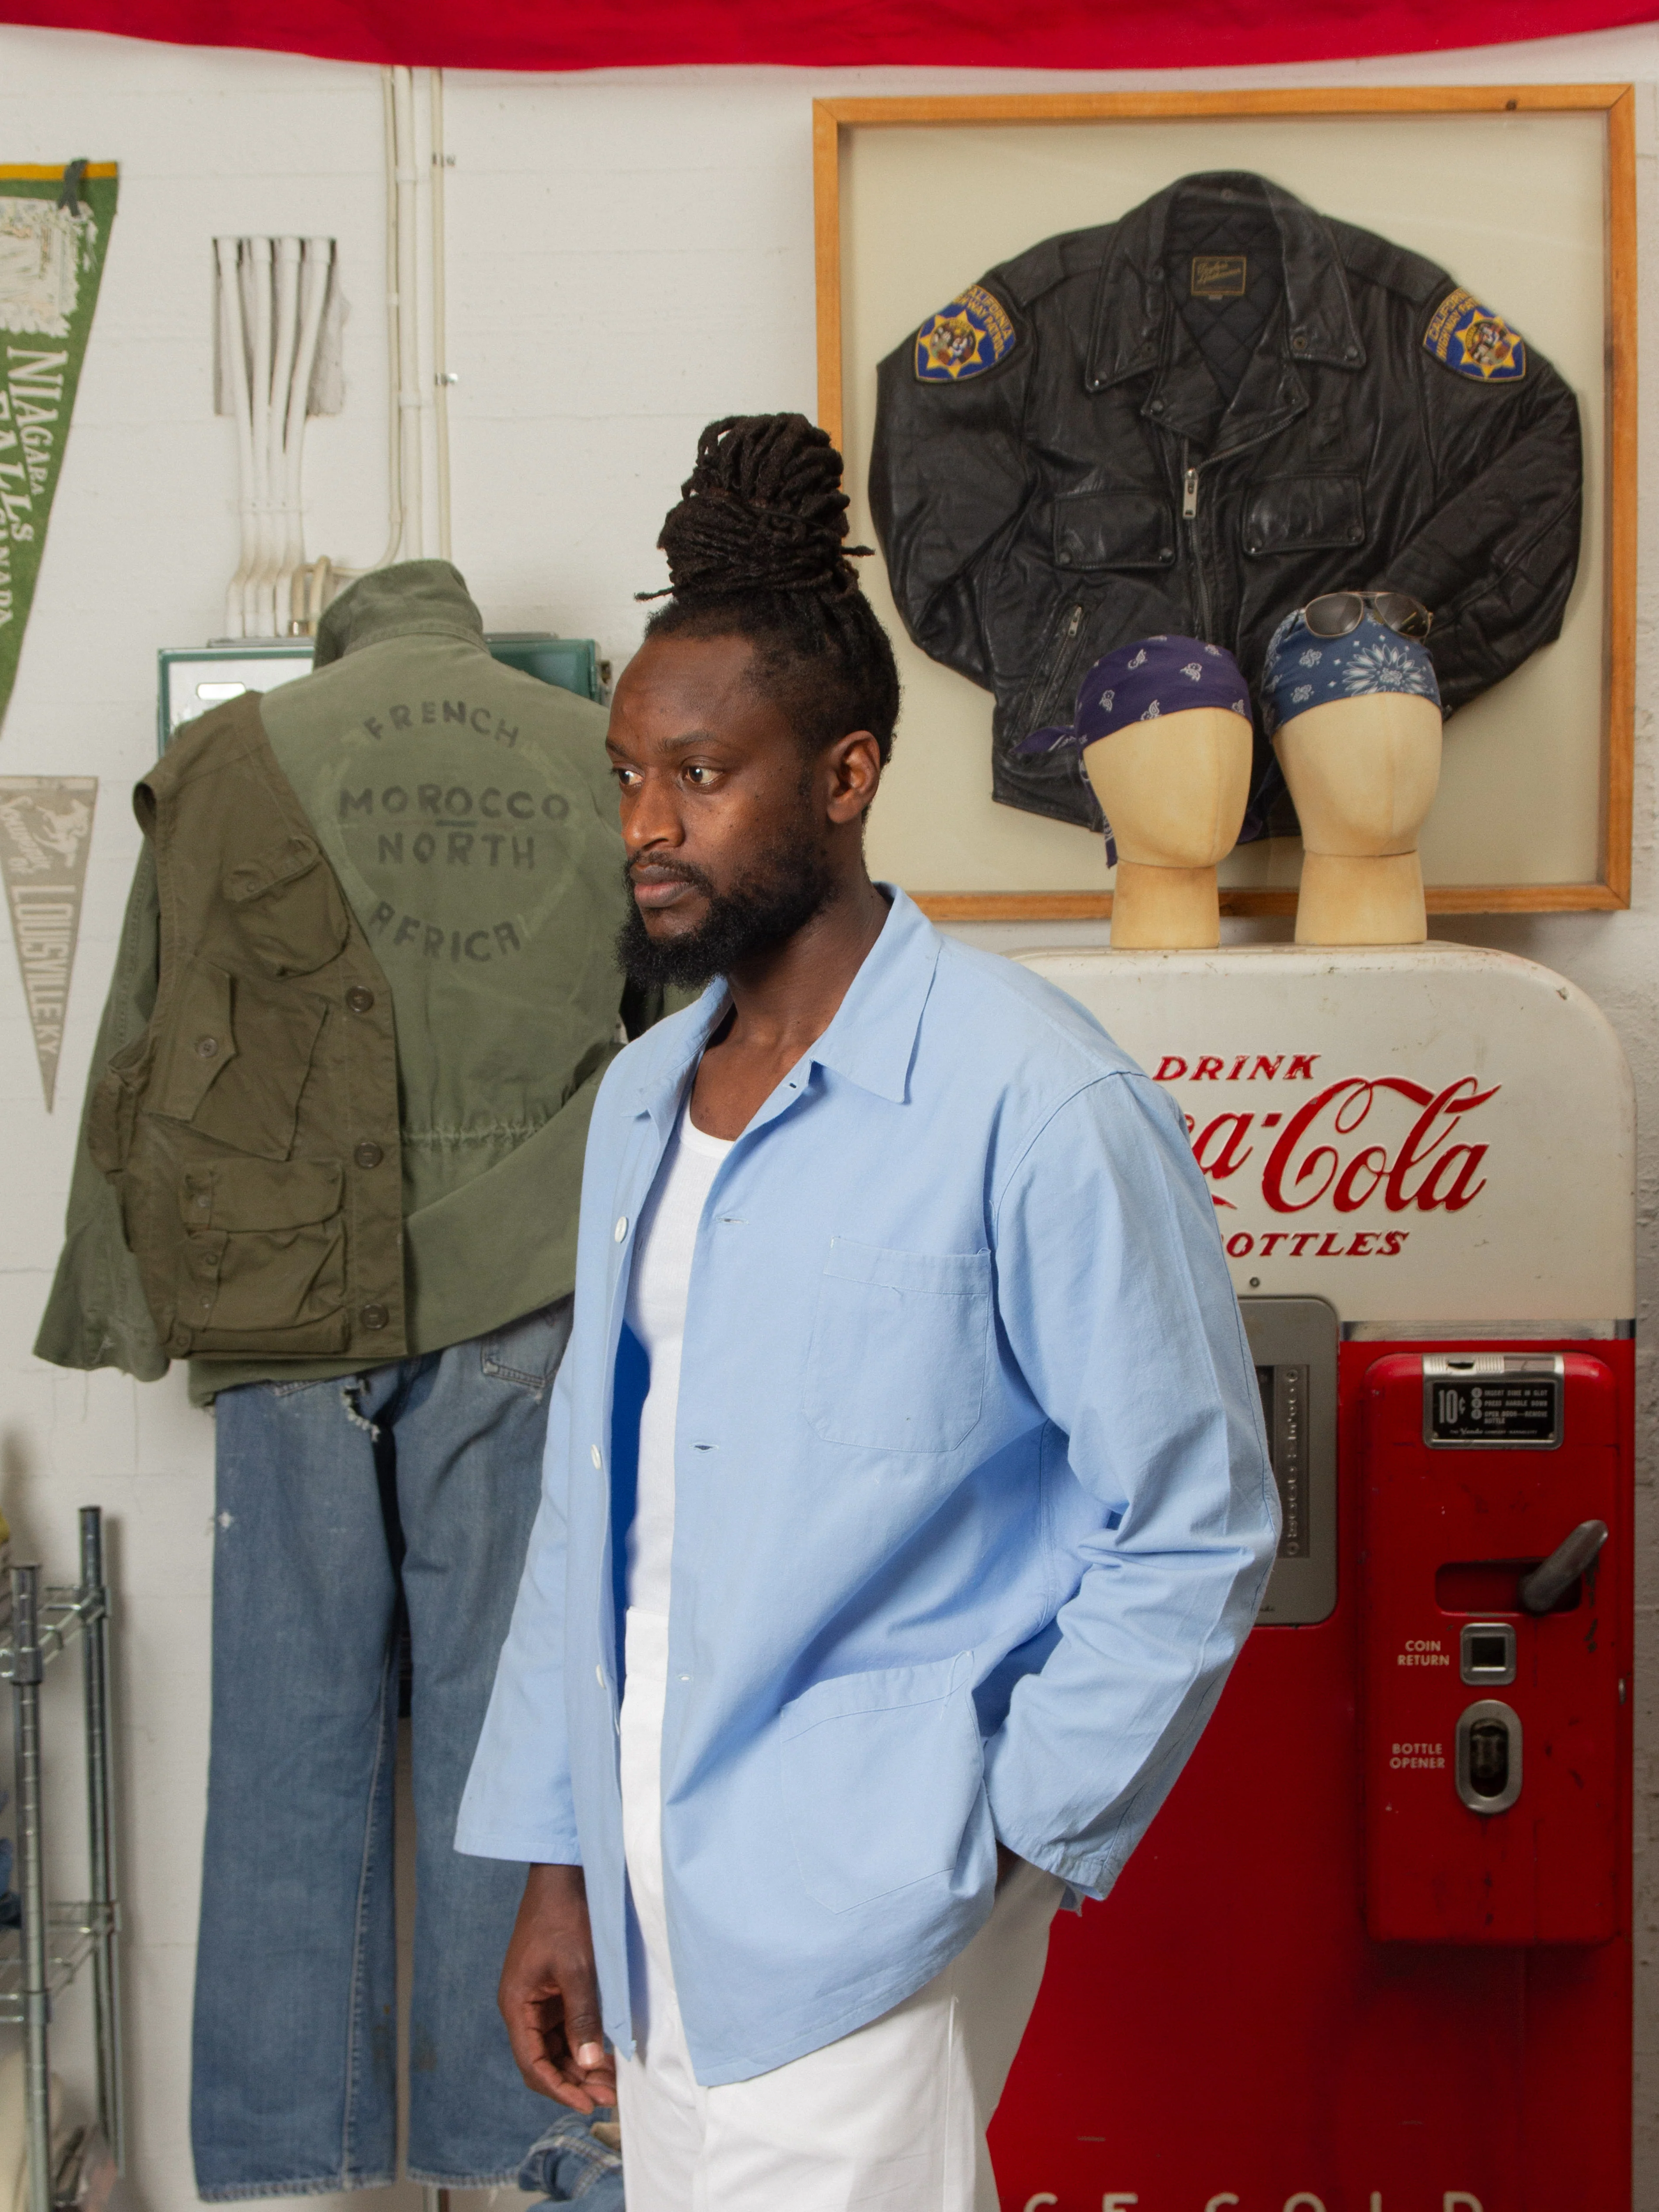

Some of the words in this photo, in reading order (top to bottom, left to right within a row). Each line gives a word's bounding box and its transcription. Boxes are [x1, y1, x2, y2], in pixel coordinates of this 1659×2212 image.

[7, 346, 69, 495] NIAGARA
[0, 390, 34, 541] LLS
[363, 700, 519, 748] FRENCH
[338, 783, 570, 821] MOROCCO
[377, 831, 535, 869] NORTH
[368, 901, 521, 963] AFRICA
[1153, 1054, 1320, 1081] DRINK
[1221, 1231, 1409, 1258] OTTLES
[1397, 1654, 1450, 1666] RETURN
[1405, 1640, 1441, 1652] COIN
[1389, 1757, 1445, 1769] OPENER
[1392, 1743, 1442, 1755] BOTTLE
